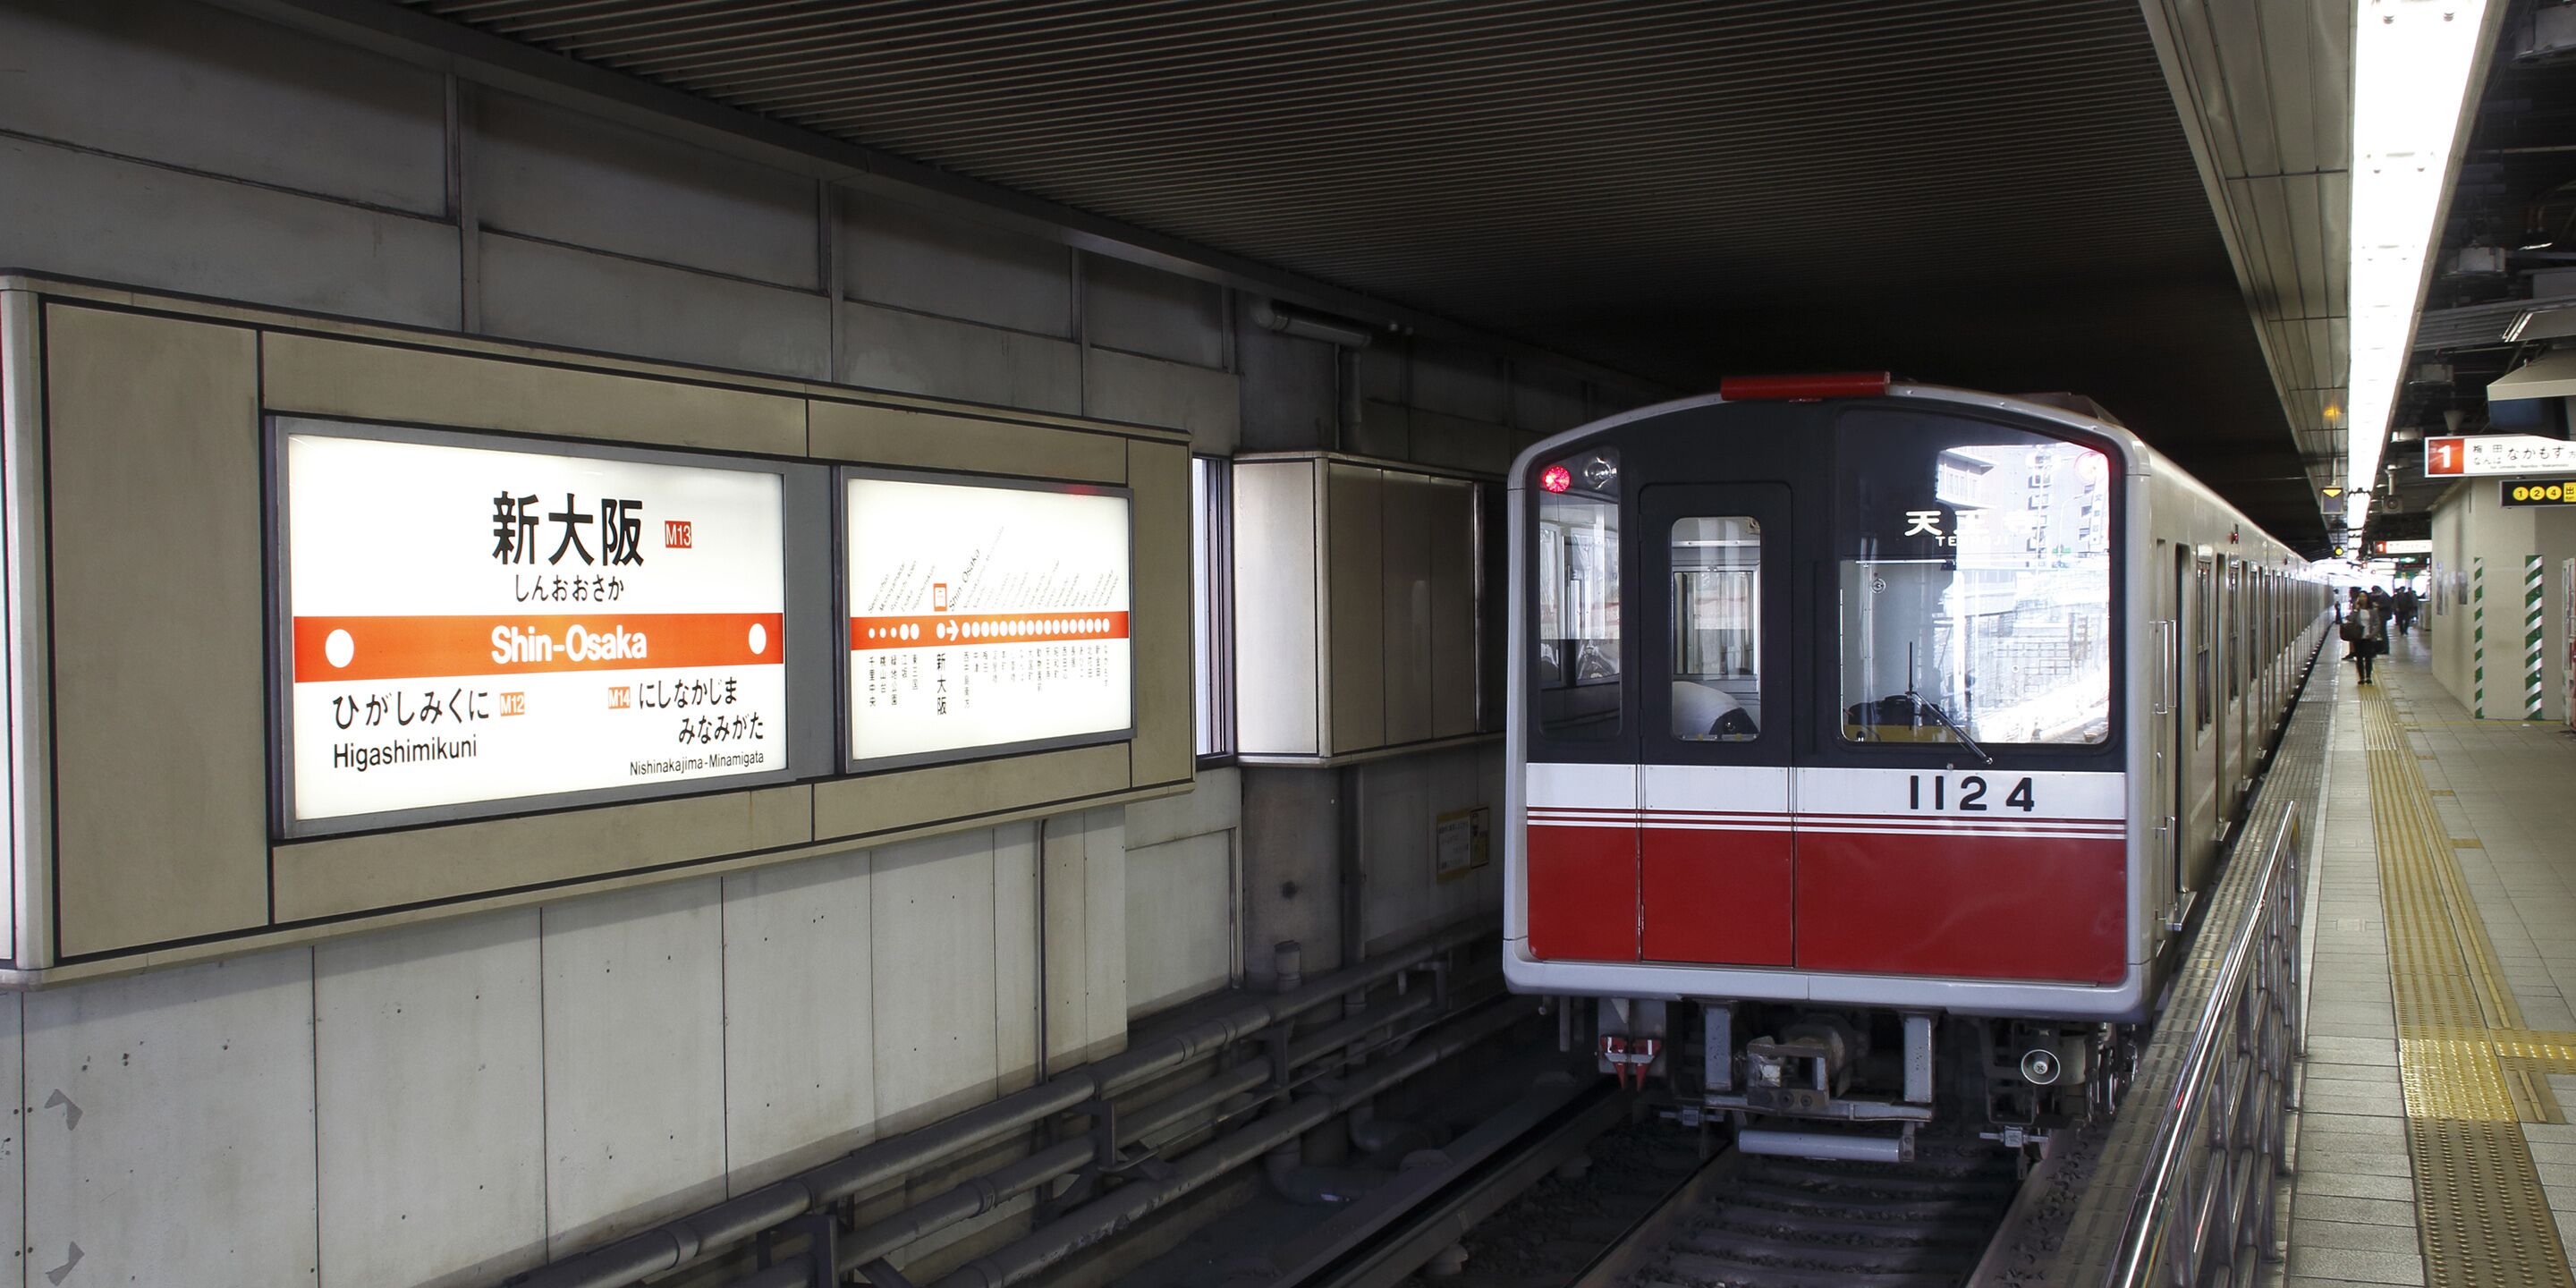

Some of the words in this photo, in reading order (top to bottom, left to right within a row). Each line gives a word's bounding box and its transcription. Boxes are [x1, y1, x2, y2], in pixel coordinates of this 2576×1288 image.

[2437, 445, 2451, 468] 1
[492, 491, 645, 567] 新大阪
[666, 522, 691, 547] M13
[2377, 543, 2384, 552] 1
[515, 574, 625, 603] しんおおさか
[491, 624, 648, 664] Shin-Osaka
[608, 688, 630, 709] M14
[639, 676, 737, 709] にしなかじま
[937, 653, 947, 716] 新大阪
[333, 688, 490, 730] ひがしみくに
[501, 694, 524, 716] M12
[678, 712, 764, 746] みなみがた
[334, 734, 478, 773] Higashimikuni
[1910, 775, 2035, 812] 1124
